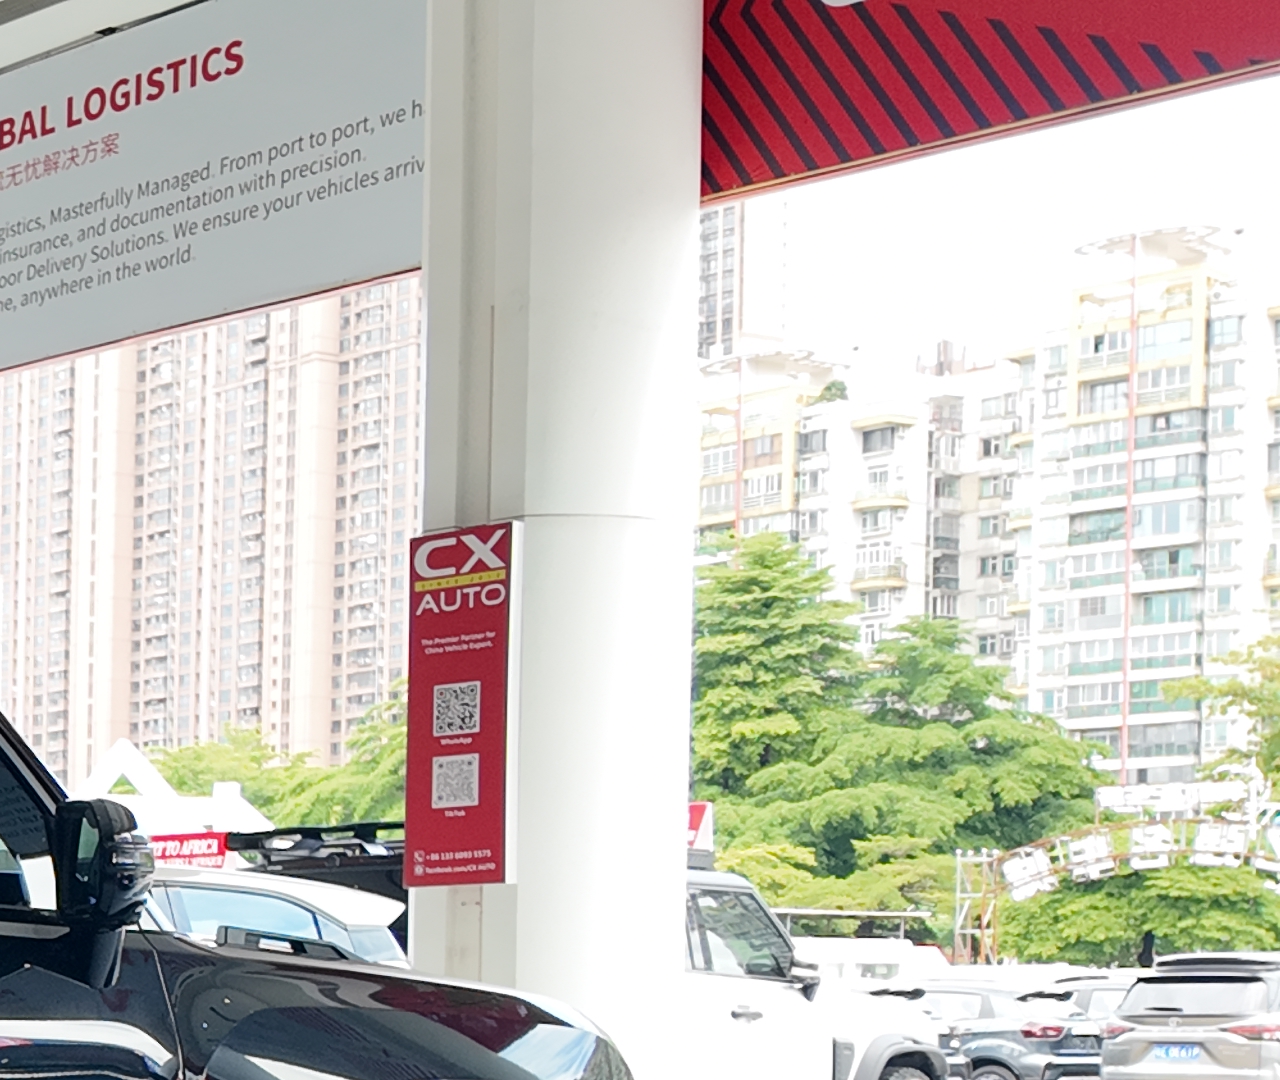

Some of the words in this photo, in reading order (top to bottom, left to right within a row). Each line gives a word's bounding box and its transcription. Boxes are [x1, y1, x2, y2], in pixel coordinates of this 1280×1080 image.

[66, 40, 244, 128] LOGISTICS
[50, 187, 133, 225] Masterfully
[137, 161, 215, 200] Managed.
[220, 150, 262, 175] From
[268, 136, 304, 165] port
[309, 131, 326, 149] to
[332, 116, 375, 146] port,
[379, 107, 406, 127] we
[410, 99, 426, 119] h
[77, 217, 106, 242] and
[110, 185, 234, 233] documentation
[239, 170, 275, 195] with
[281, 148, 366, 188] precision.
[27, 253, 86, 284] Delivery
[90, 230, 168, 264] Solutions.
[173, 220, 198, 240] We
[202, 204, 259, 232] ensure
[263, 191, 303, 220] your
[307, 169, 379, 203] vehicles
[20, 274, 93, 307] anywhere
[97, 268, 111, 286] in
[116, 260, 141, 281] the
[145, 243, 196, 273] world.
[414, 529, 506, 578] CX
[416, 583, 506, 616] AUTO
